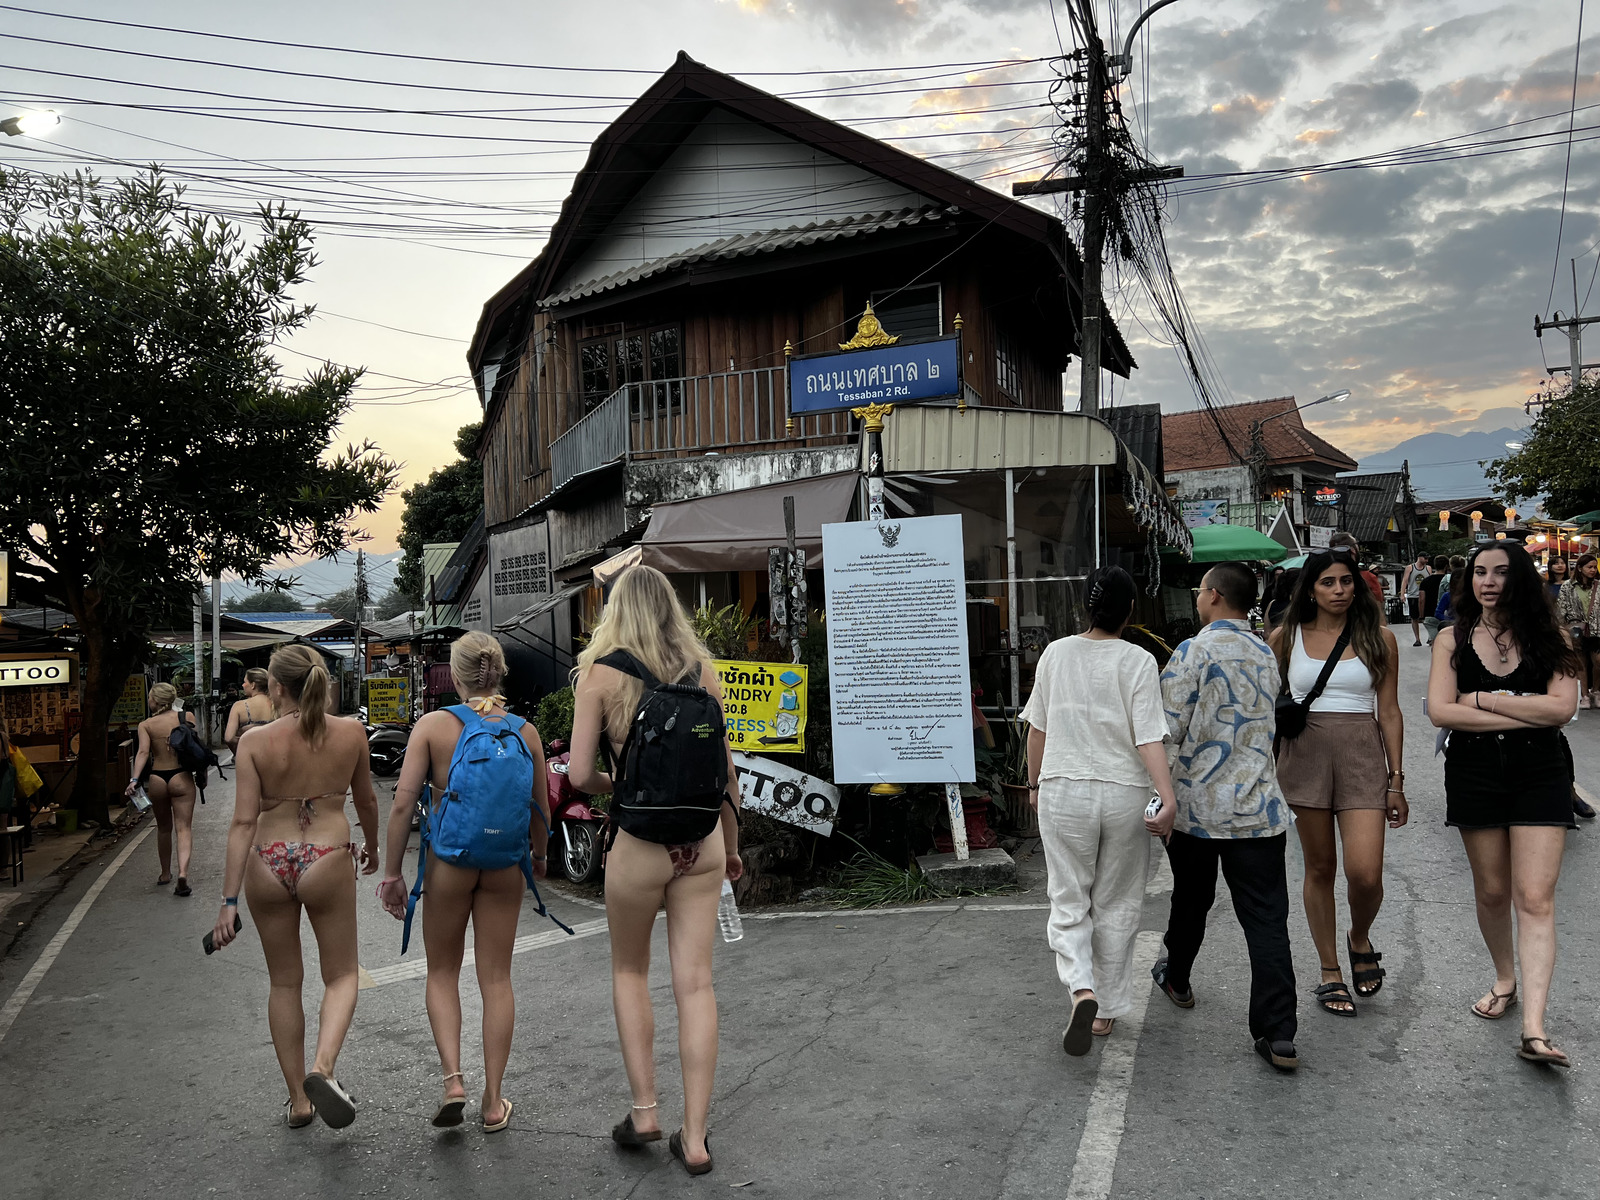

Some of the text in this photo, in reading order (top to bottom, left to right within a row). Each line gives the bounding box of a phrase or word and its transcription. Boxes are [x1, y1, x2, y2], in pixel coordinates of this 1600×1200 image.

[806, 358, 940, 393] ถนนเทศบาล ๒
[838, 385, 911, 402] Tessaban 2 Rd.
[726, 717, 766, 733] RESS
